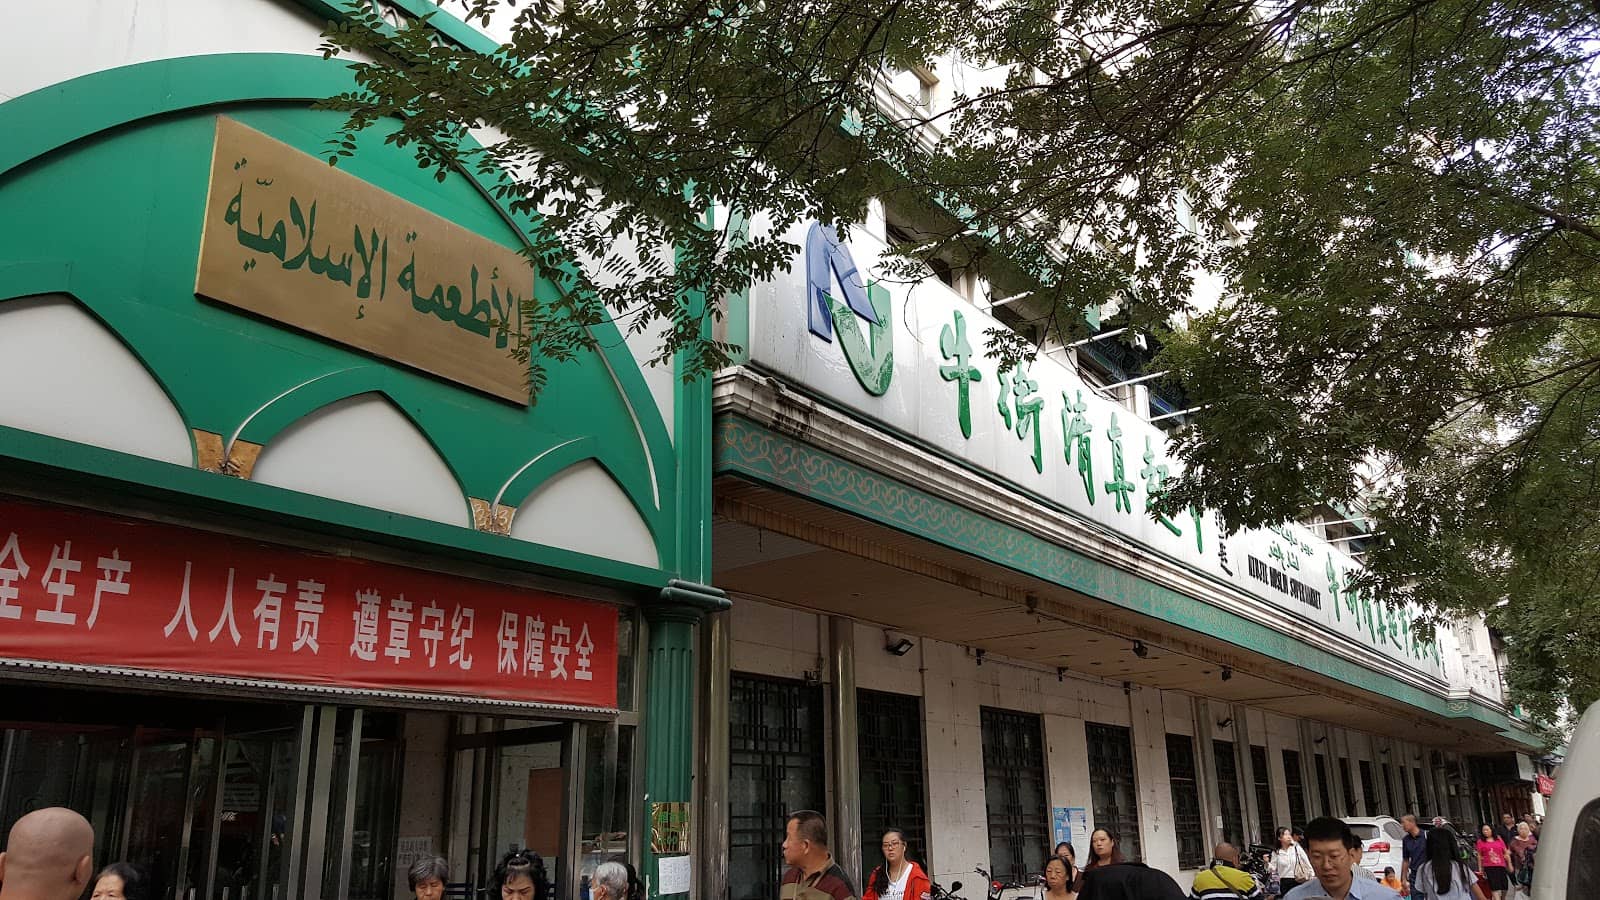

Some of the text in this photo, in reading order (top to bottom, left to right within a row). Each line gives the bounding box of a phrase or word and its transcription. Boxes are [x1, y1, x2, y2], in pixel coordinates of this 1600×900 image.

[0, 532, 595, 682] 全生产 人人有责 遵章守纪 保障安全
